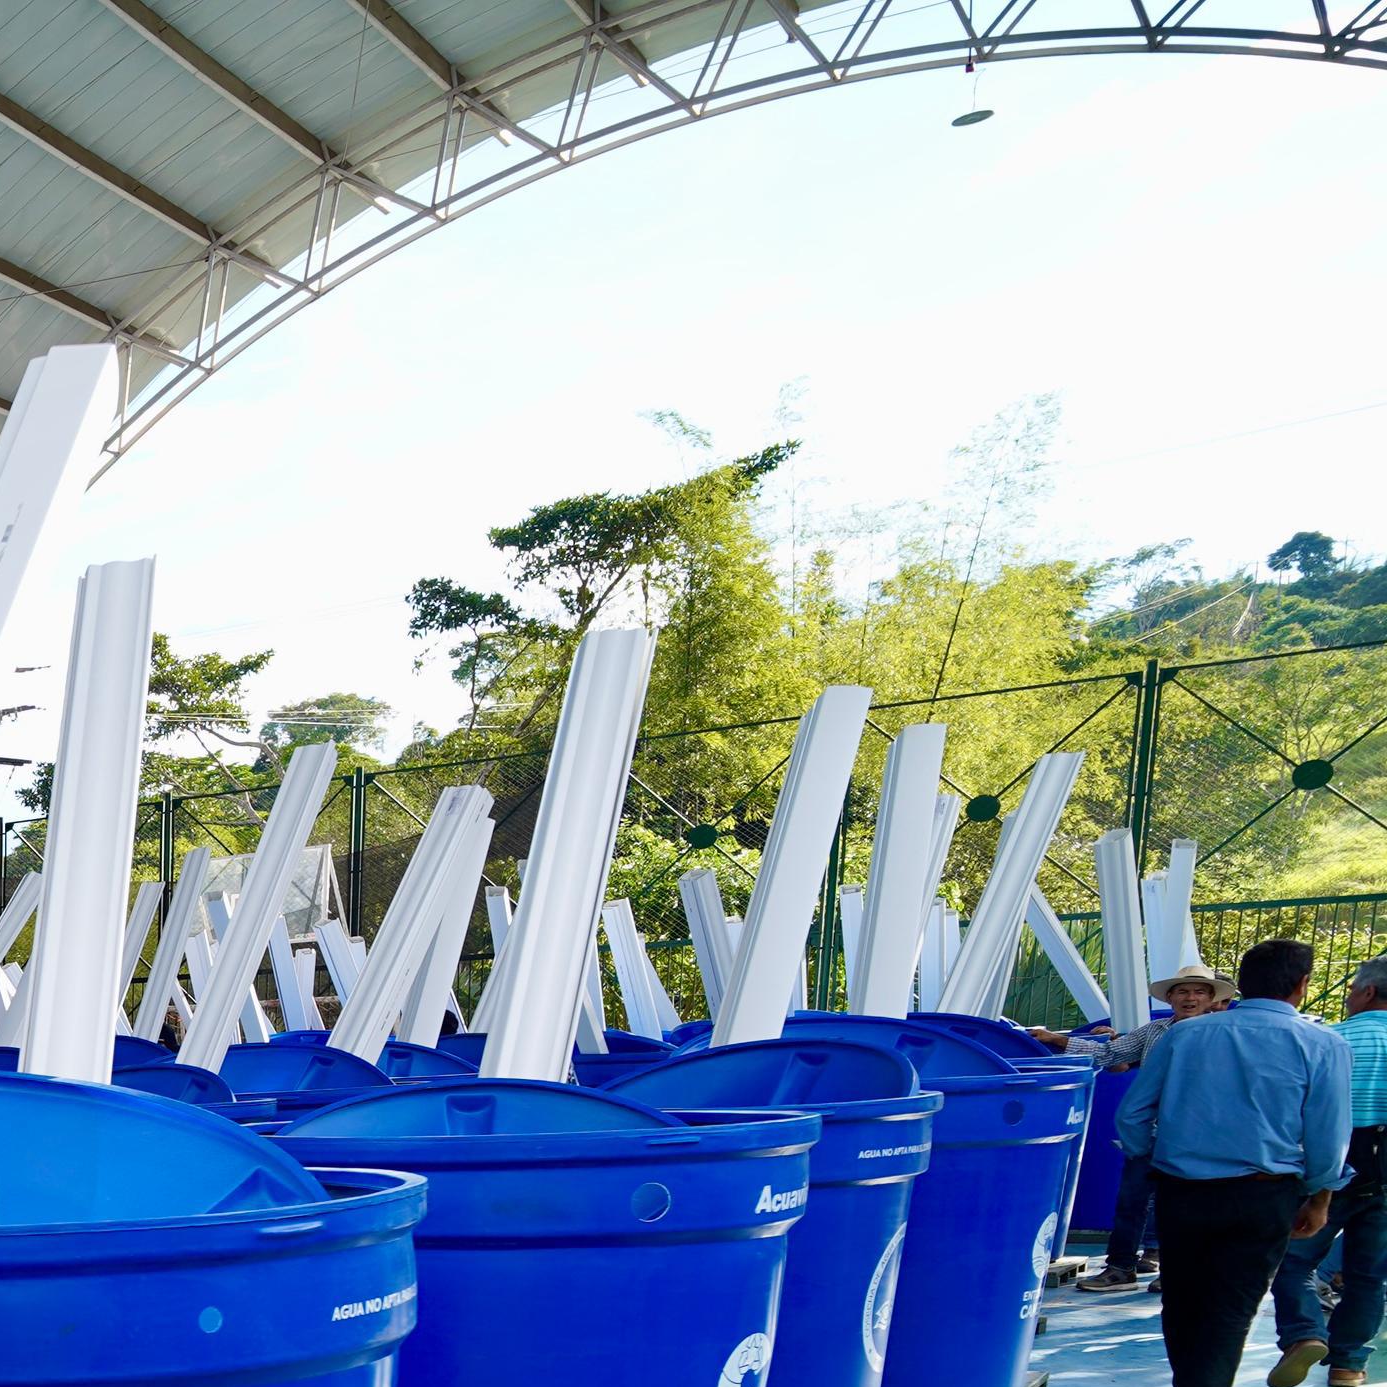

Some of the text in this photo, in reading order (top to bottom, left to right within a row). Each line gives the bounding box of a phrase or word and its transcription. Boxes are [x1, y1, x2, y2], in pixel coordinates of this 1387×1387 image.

[858, 1150, 881, 1159] AGUA
[882, 1148, 893, 1157] NO
[331, 1302, 365, 1321] AGUA
[365, 1298, 382, 1314] NO
